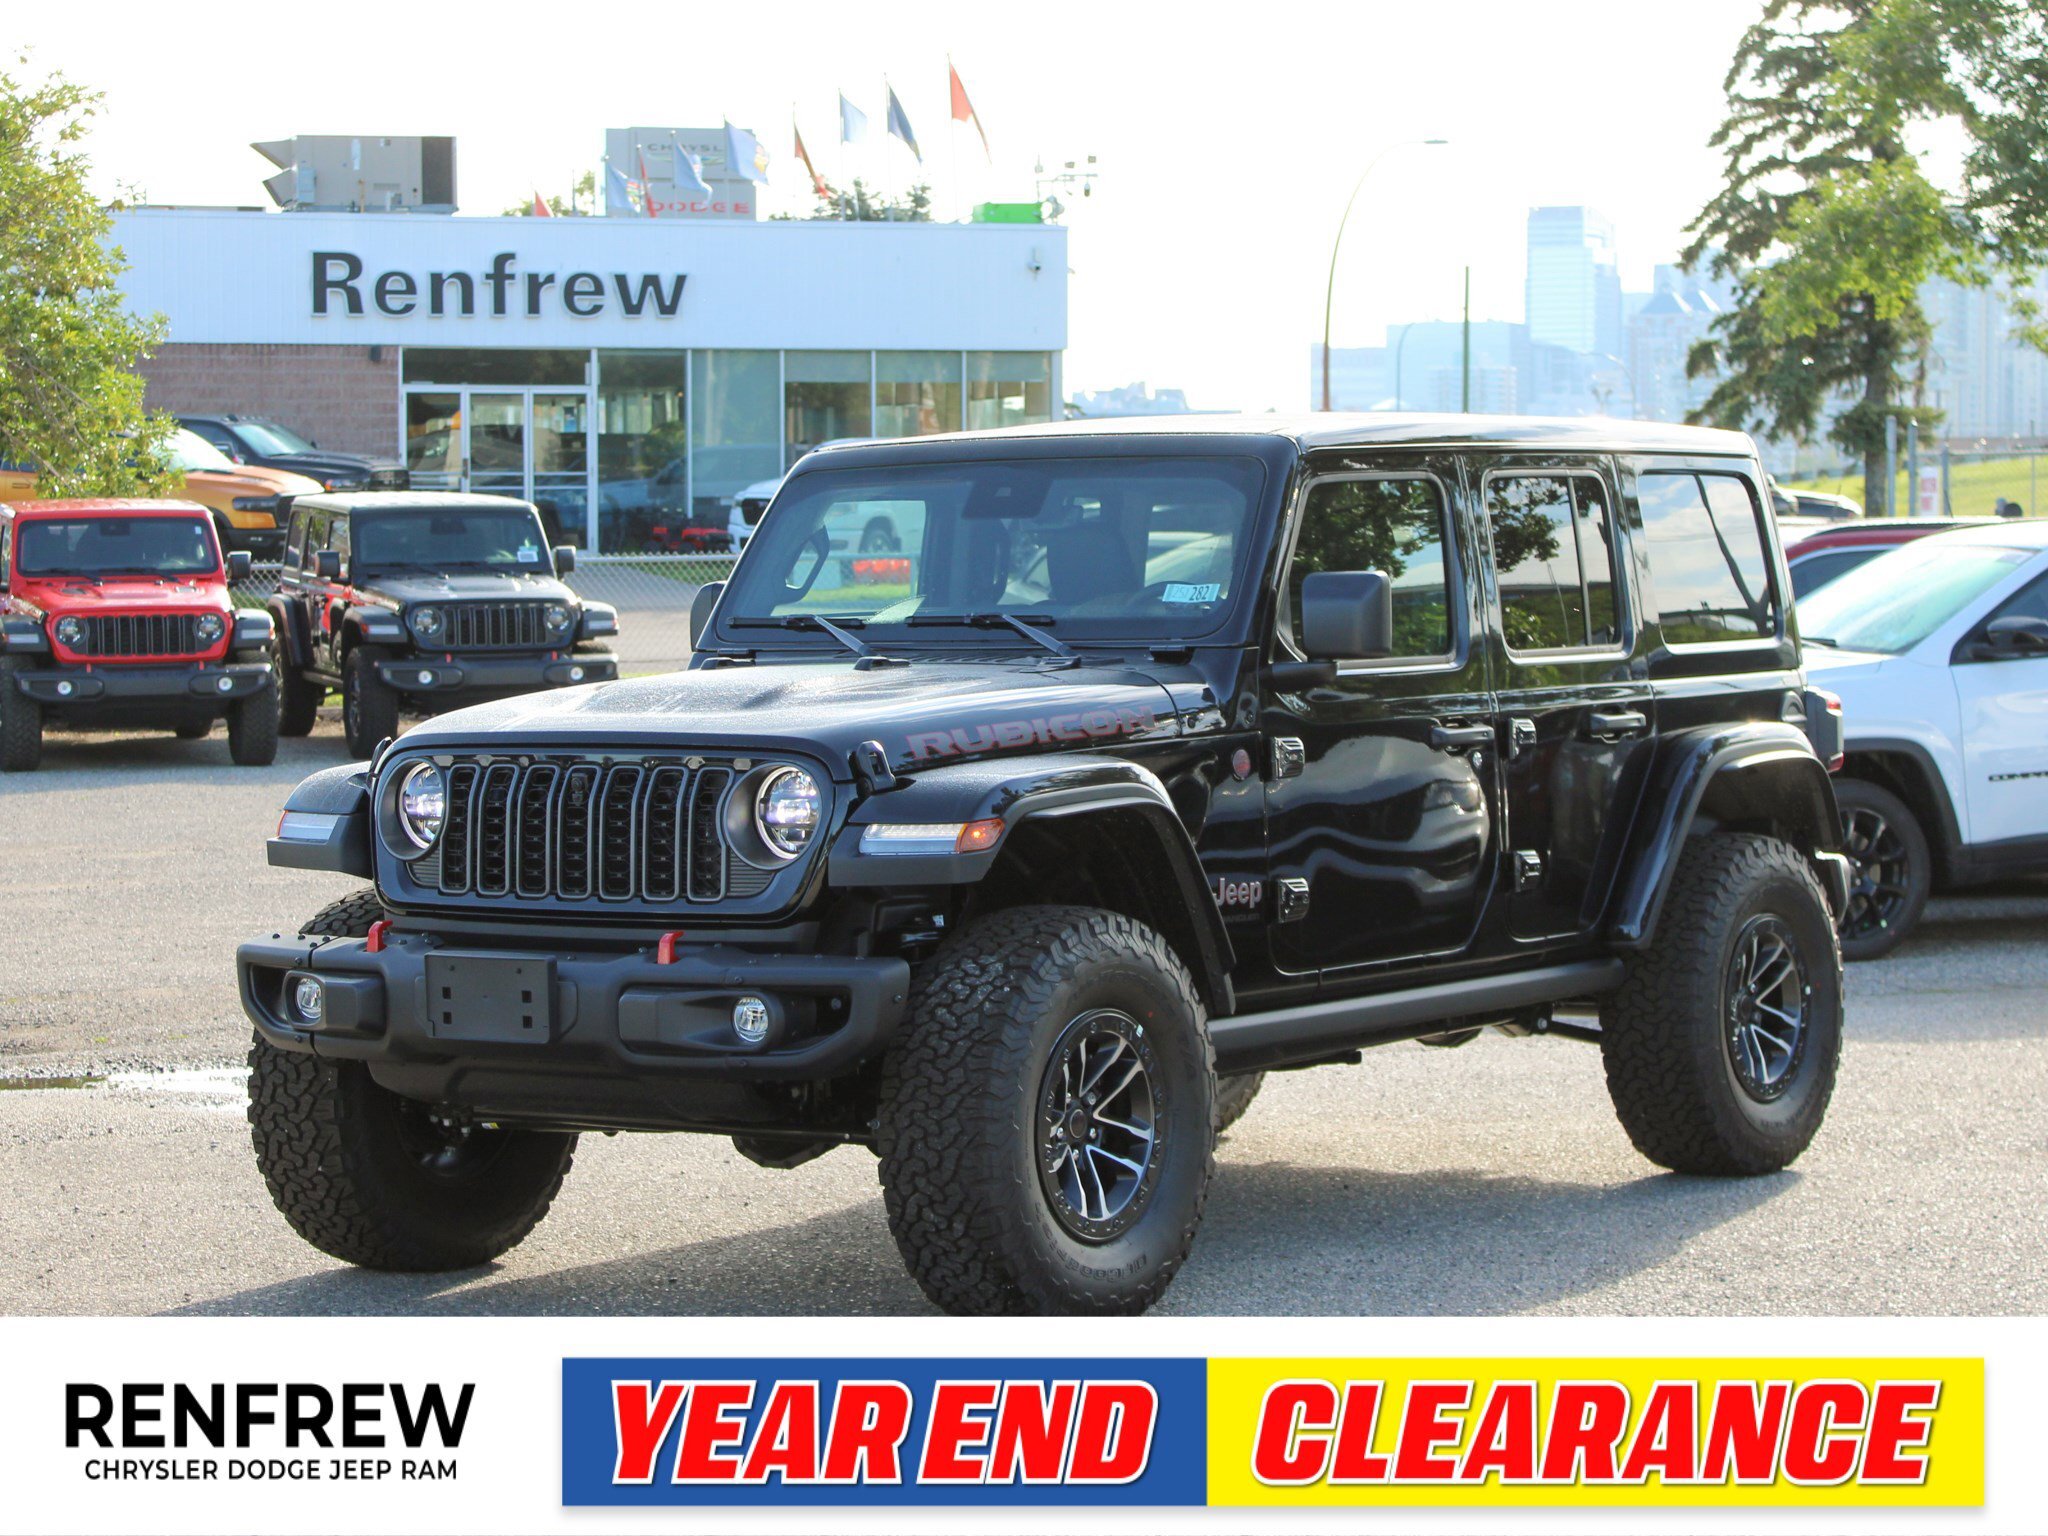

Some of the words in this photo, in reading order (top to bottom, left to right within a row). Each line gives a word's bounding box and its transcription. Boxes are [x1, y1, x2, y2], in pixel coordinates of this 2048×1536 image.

[312, 251, 687, 316] Renfrew
[906, 705, 1156, 761] RUBICON
[1212, 877, 1263, 909] Jeep
